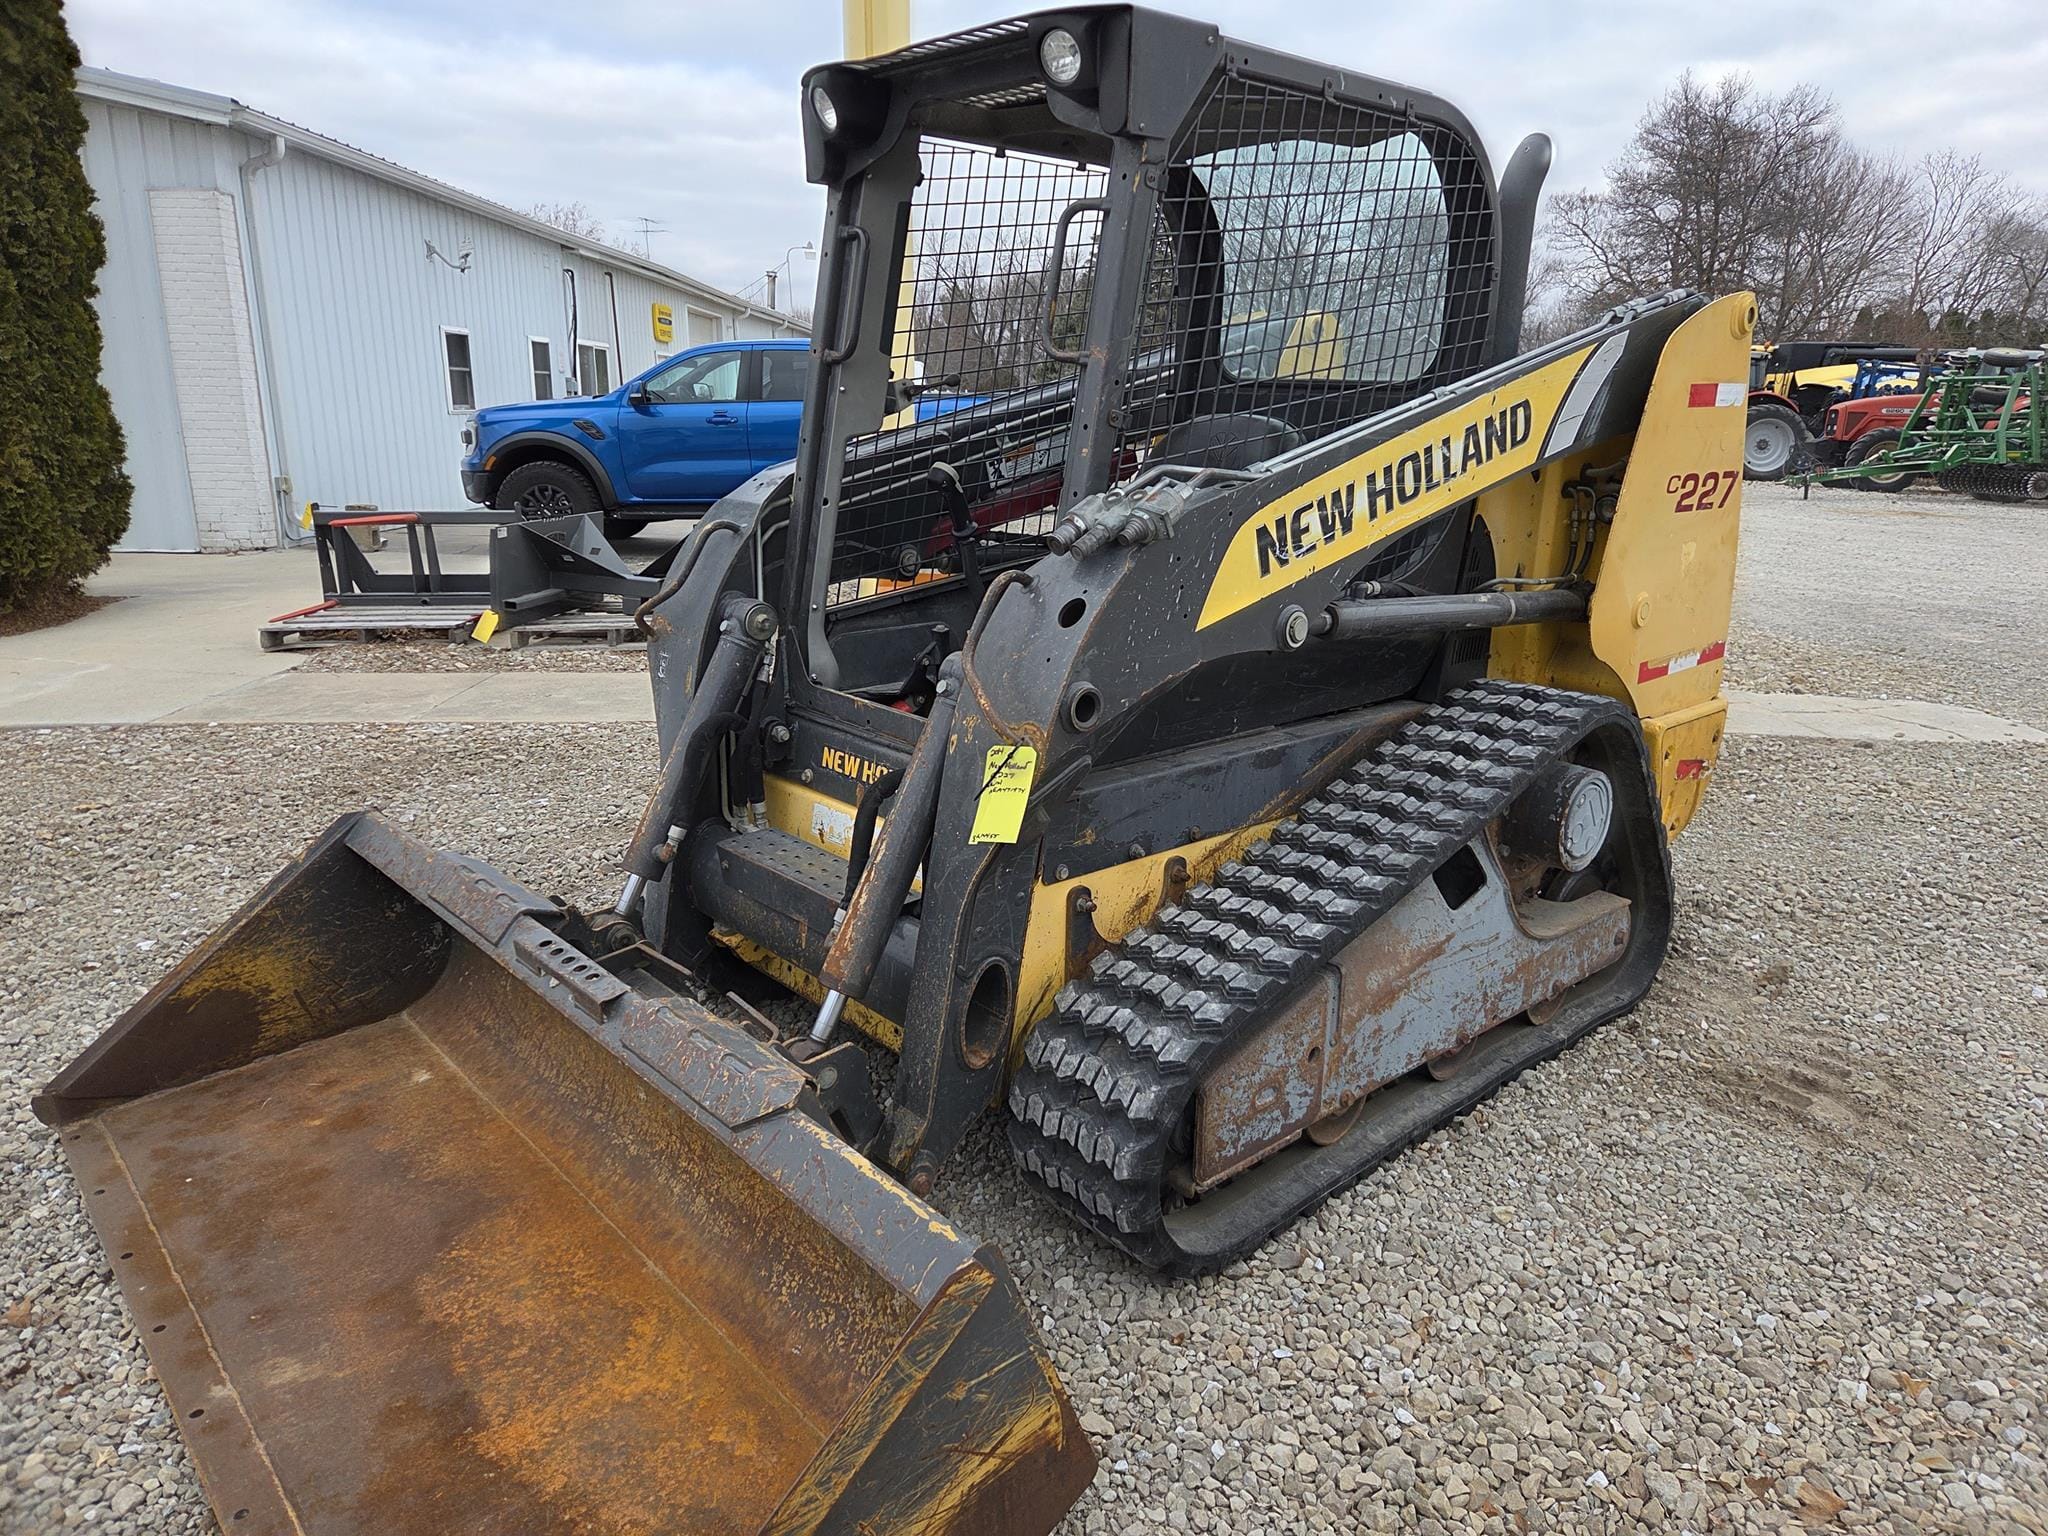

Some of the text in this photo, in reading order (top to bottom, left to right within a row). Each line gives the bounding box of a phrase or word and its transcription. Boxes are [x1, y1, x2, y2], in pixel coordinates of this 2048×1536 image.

[1255, 398, 1532, 579] NEW HOLLAND
[821, 746, 860, 779] NEW
